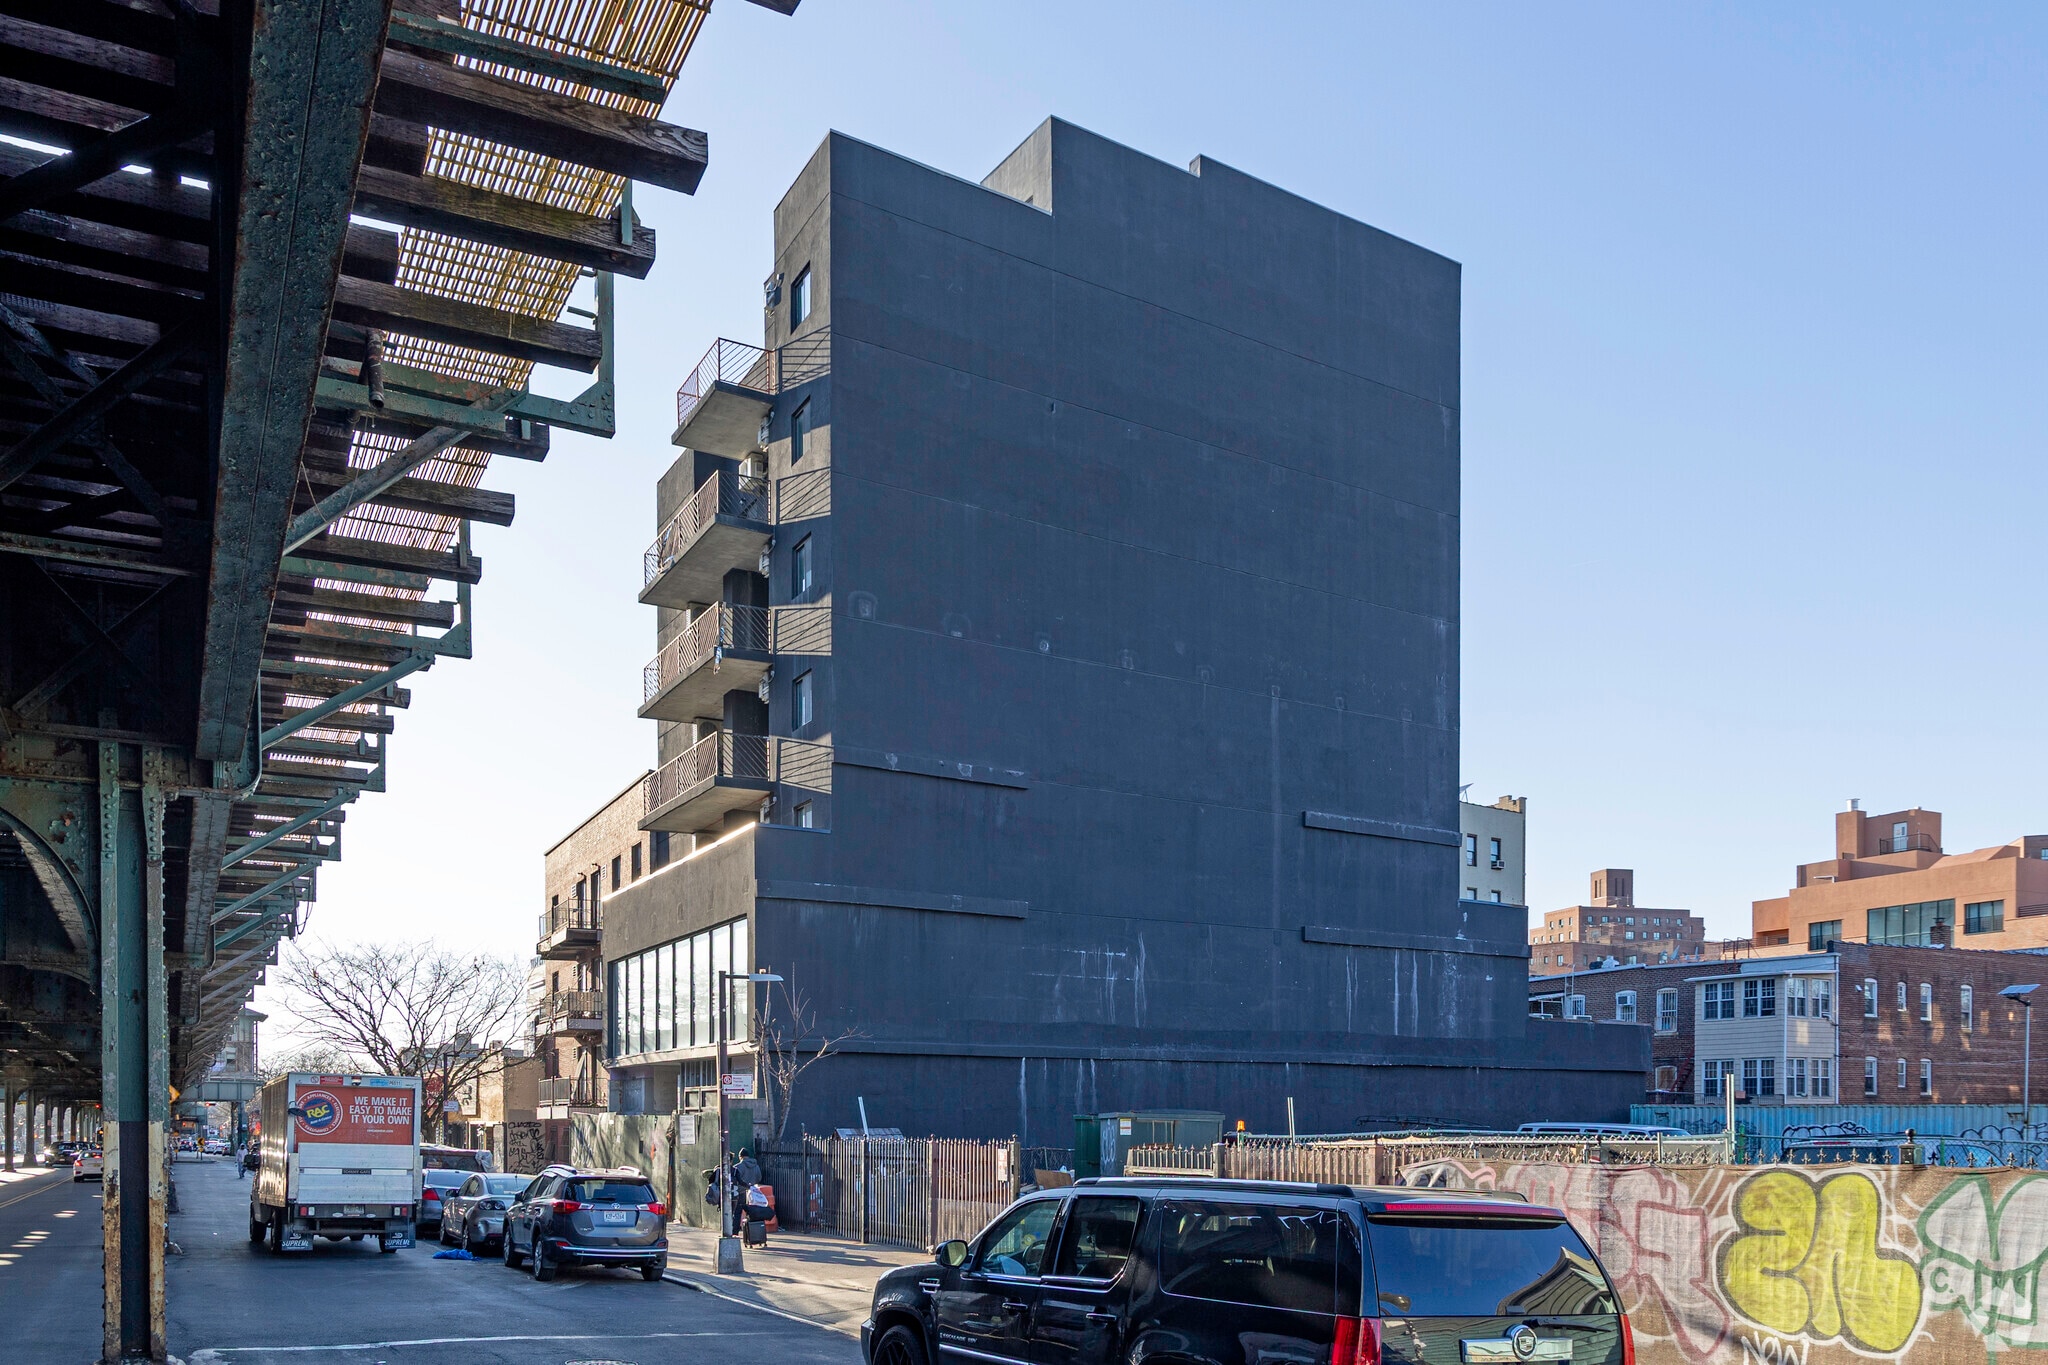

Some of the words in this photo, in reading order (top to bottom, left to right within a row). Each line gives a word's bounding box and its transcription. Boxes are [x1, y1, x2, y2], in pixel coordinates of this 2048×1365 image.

[354, 1096, 369, 1105] WE
[371, 1097, 397, 1106] MAKE
[399, 1098, 408, 1107] IT
[306, 1105, 330, 1118] RAC
[349, 1105, 371, 1115] EASY
[373, 1106, 385, 1115] TO
[387, 1107, 412, 1116] MAKE
[351, 1115, 360, 1124] IT
[362, 1115, 385, 1124] YOUR
[387, 1116, 410, 1125] OWN
